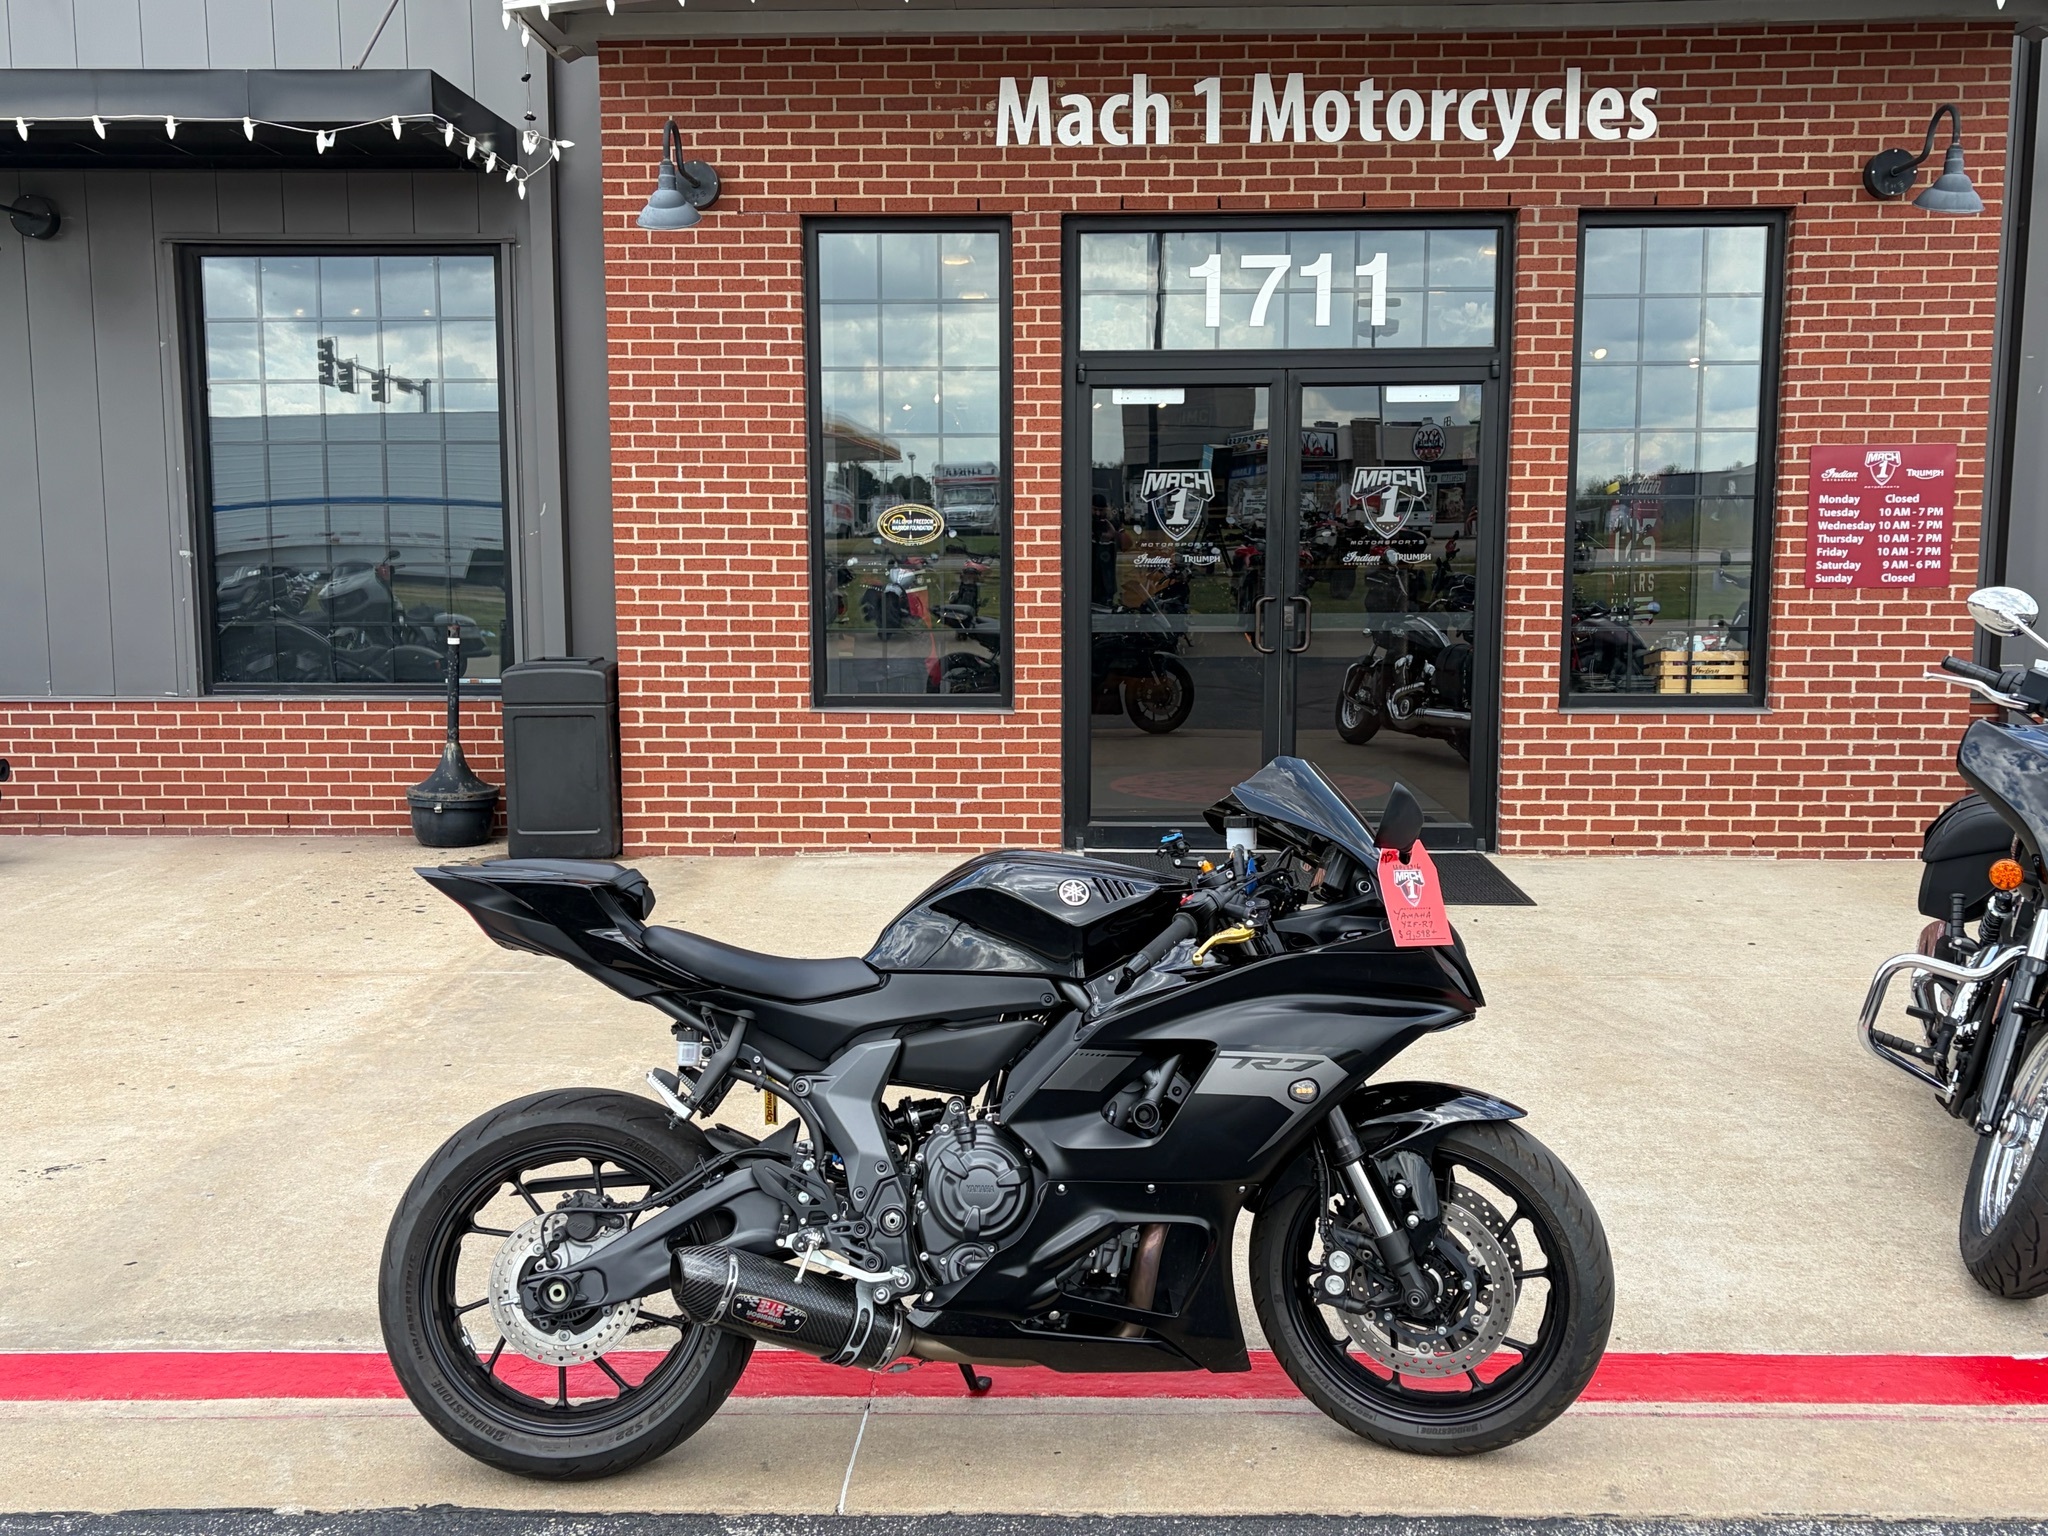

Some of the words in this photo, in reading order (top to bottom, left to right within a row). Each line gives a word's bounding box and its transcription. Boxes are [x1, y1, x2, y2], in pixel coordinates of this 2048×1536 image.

[996, 73, 1170, 148] Mach
[1193, 76, 1220, 145] 1
[1249, 66, 1658, 161] Motorcycles
[1189, 252, 1387, 328] 1711
[1867, 452, 1900, 462] MACH
[1821, 467, 1858, 478] Indian
[1876, 460, 1888, 478] 1
[1906, 468, 1944, 478] TRIUMPH
[1144, 472, 1212, 496] MACH
[1354, 470, 1424, 493] MACH
[1376, 485, 1400, 522] 1
[1819, 494, 1860, 505] Monday
[1885, 494, 1920, 503] Closed
[1165, 488, 1189, 524] 1
[1818, 508, 1860, 518] Tuesday
[1879, 507, 1892, 516] 10
[1893, 507, 1911, 516] AM
[1918, 507, 1924, 516] 7
[1927, 507, 1944, 516] PM
[1818, 521, 1876, 532] Wednesday
[1878, 520, 1891, 530] 10
[1892, 520, 1910, 530] AM
[1918, 520, 1924, 530] 7
[1926, 520, 1942, 530] PM
[1817, 534, 1864, 545] Thursday
[1878, 534, 1890, 543] 10
[1892, 534, 1910, 543] AM
[1917, 534, 1923, 543] 7
[1926, 534, 1942, 543] PM
[1342, 551, 1381, 562] Indian
[1393, 552, 1432, 562] TRIUMPH
[1816, 547, 1848, 558] Friday
[1877, 547, 1890, 556] 10
[1891, 547, 1908, 556] AM
[1916, 547, 1923, 556] 7
[1925, 547, 1941, 556] PM
[1133, 553, 1171, 564] Indian
[1182, 554, 1221, 564] TRIUMPH
[1816, 560, 1861, 572] Saturday
[1882, 560, 1889, 570] 9
[1891, 560, 1908, 570] AM
[1916, 560, 1922, 570] 6
[1925, 560, 1941, 570] PM
[1815, 573, 1853, 584] Sunday
[1881, 573, 1915, 582] Closed
[1395, 871, 1424, 883] MACH
[1406, 880, 1418, 898] 1
[966, 1185, 995, 1193] YAMAHA
[746, 1310, 786, 1325] YOSHIMURA
[431, 1380, 507, 1441] BRIDGESTONE
[1420, 1423, 1479, 1434] BRIDGESTONE
